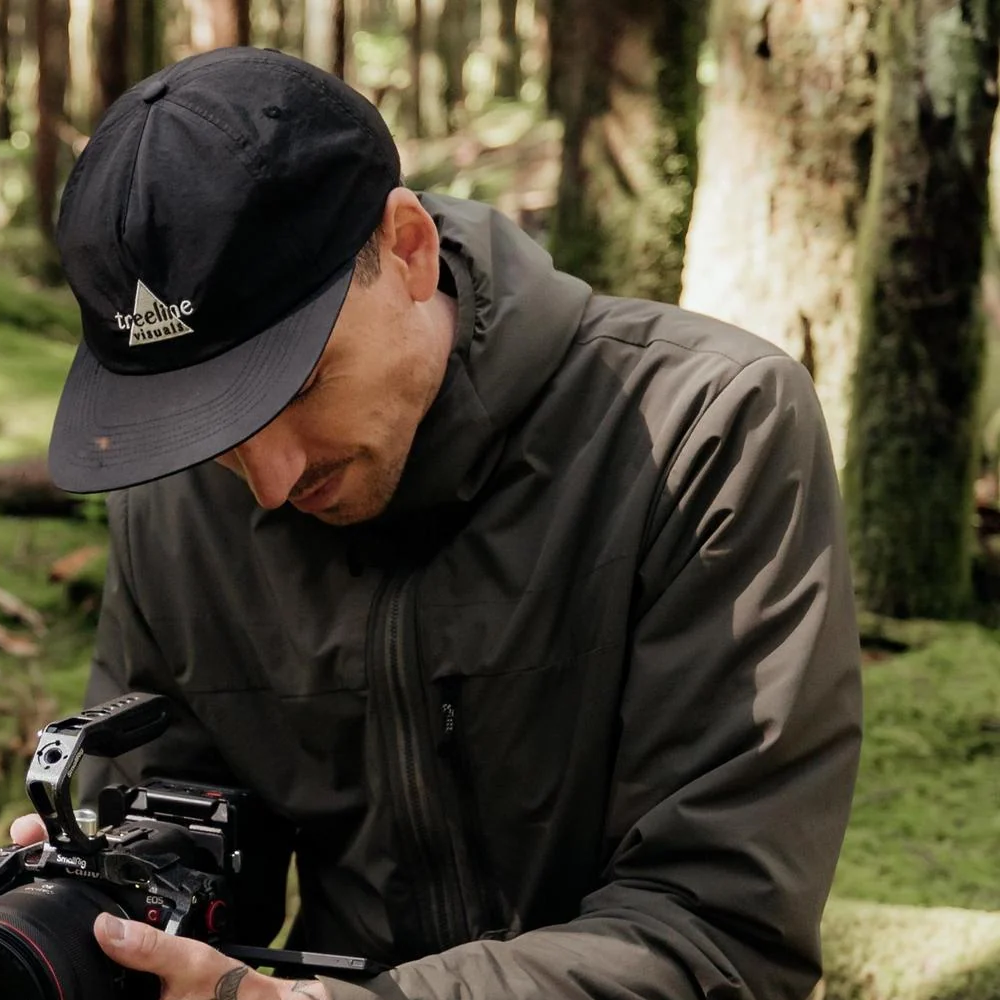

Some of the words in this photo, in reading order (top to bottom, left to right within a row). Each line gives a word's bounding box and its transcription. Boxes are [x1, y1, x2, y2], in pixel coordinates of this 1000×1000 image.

[115, 300, 194, 330] treeline
[133, 322, 185, 340] visuals
[56, 854, 87, 869] SmallRig
[146, 895, 164, 905] EOS
